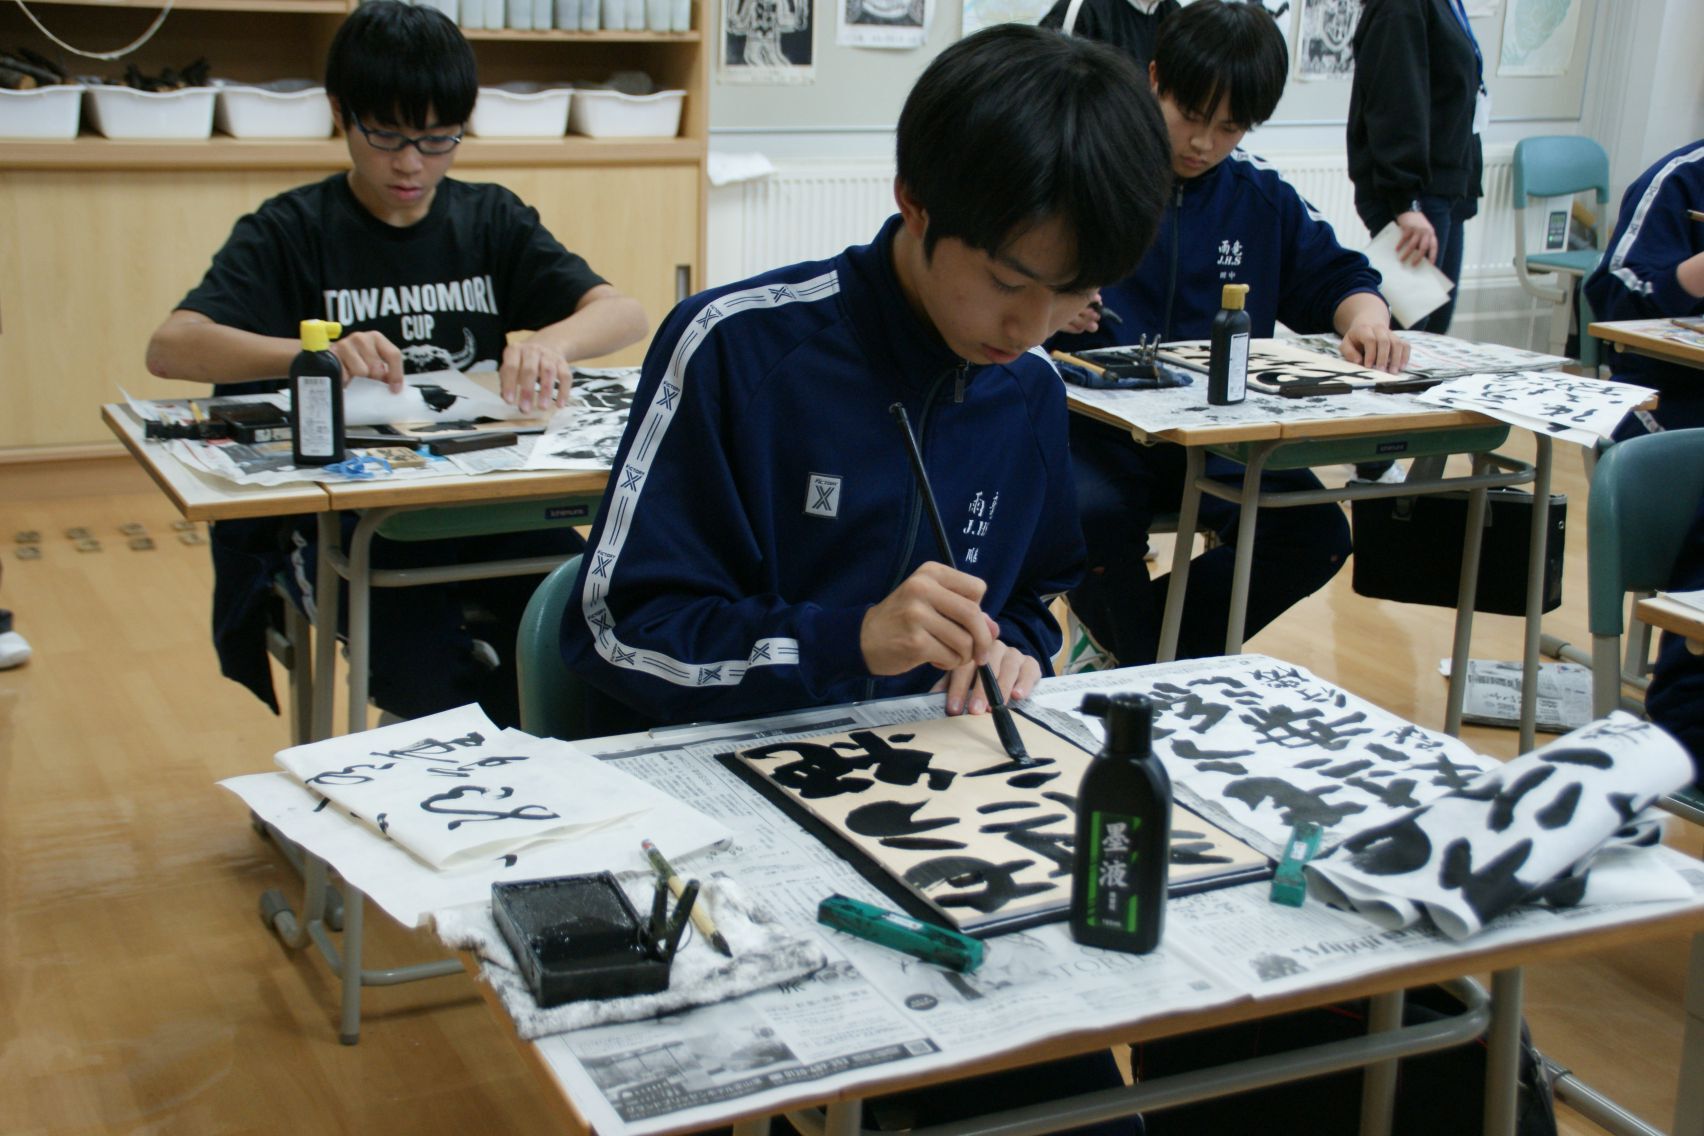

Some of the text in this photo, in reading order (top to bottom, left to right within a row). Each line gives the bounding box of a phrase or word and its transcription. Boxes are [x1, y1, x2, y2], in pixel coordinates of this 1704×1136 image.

[323, 275, 499, 326] TOWANOMORI
[401, 314, 436, 341] CUP
[1099, 821, 1130, 888] 墨液
